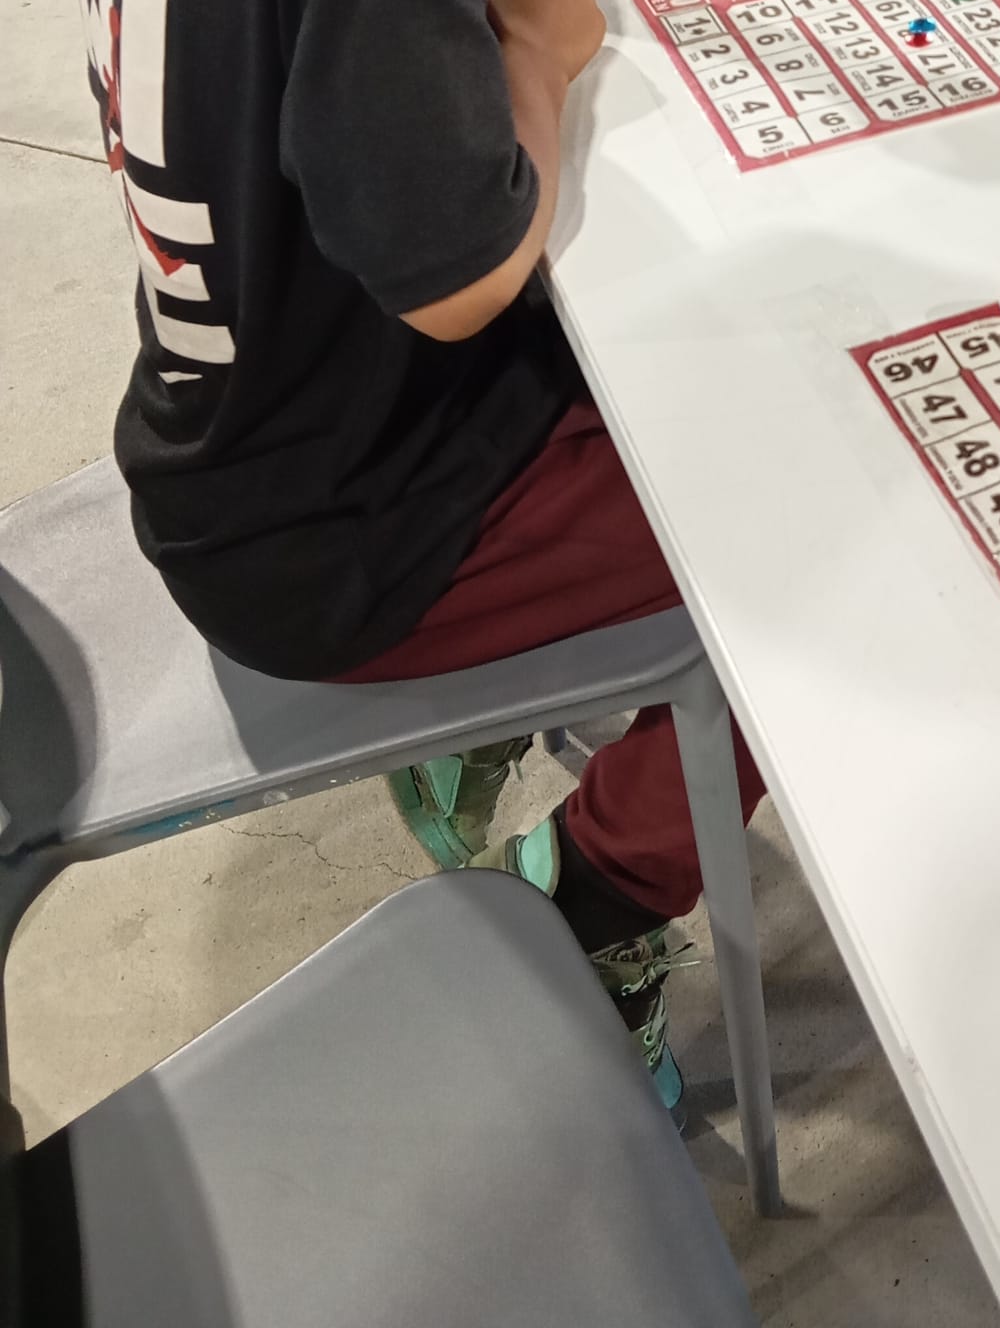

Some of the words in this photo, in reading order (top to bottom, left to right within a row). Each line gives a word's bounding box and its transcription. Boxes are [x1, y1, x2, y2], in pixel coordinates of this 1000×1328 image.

[736, 6, 782, 23] 10
[826, 12, 858, 34] 12
[756, 34, 784, 46] 9
[700, 40, 731, 59] 2
[775, 60, 804, 72] 8
[918, 54, 954, 74] 17
[721, 70, 748, 84] 3
[866, 65, 904, 87] 14
[794, 90, 824, 100] 7
[938, 78, 986, 96] 16
[742, 102, 769, 114] 4
[878, 90, 926, 110] 15
[820, 113, 844, 126] 6
[758, 126, 782, 144] 5
[884, 354, 938, 382] 46
[923, 395, 968, 424] 47
[956, 442, 1000, 478] 48
